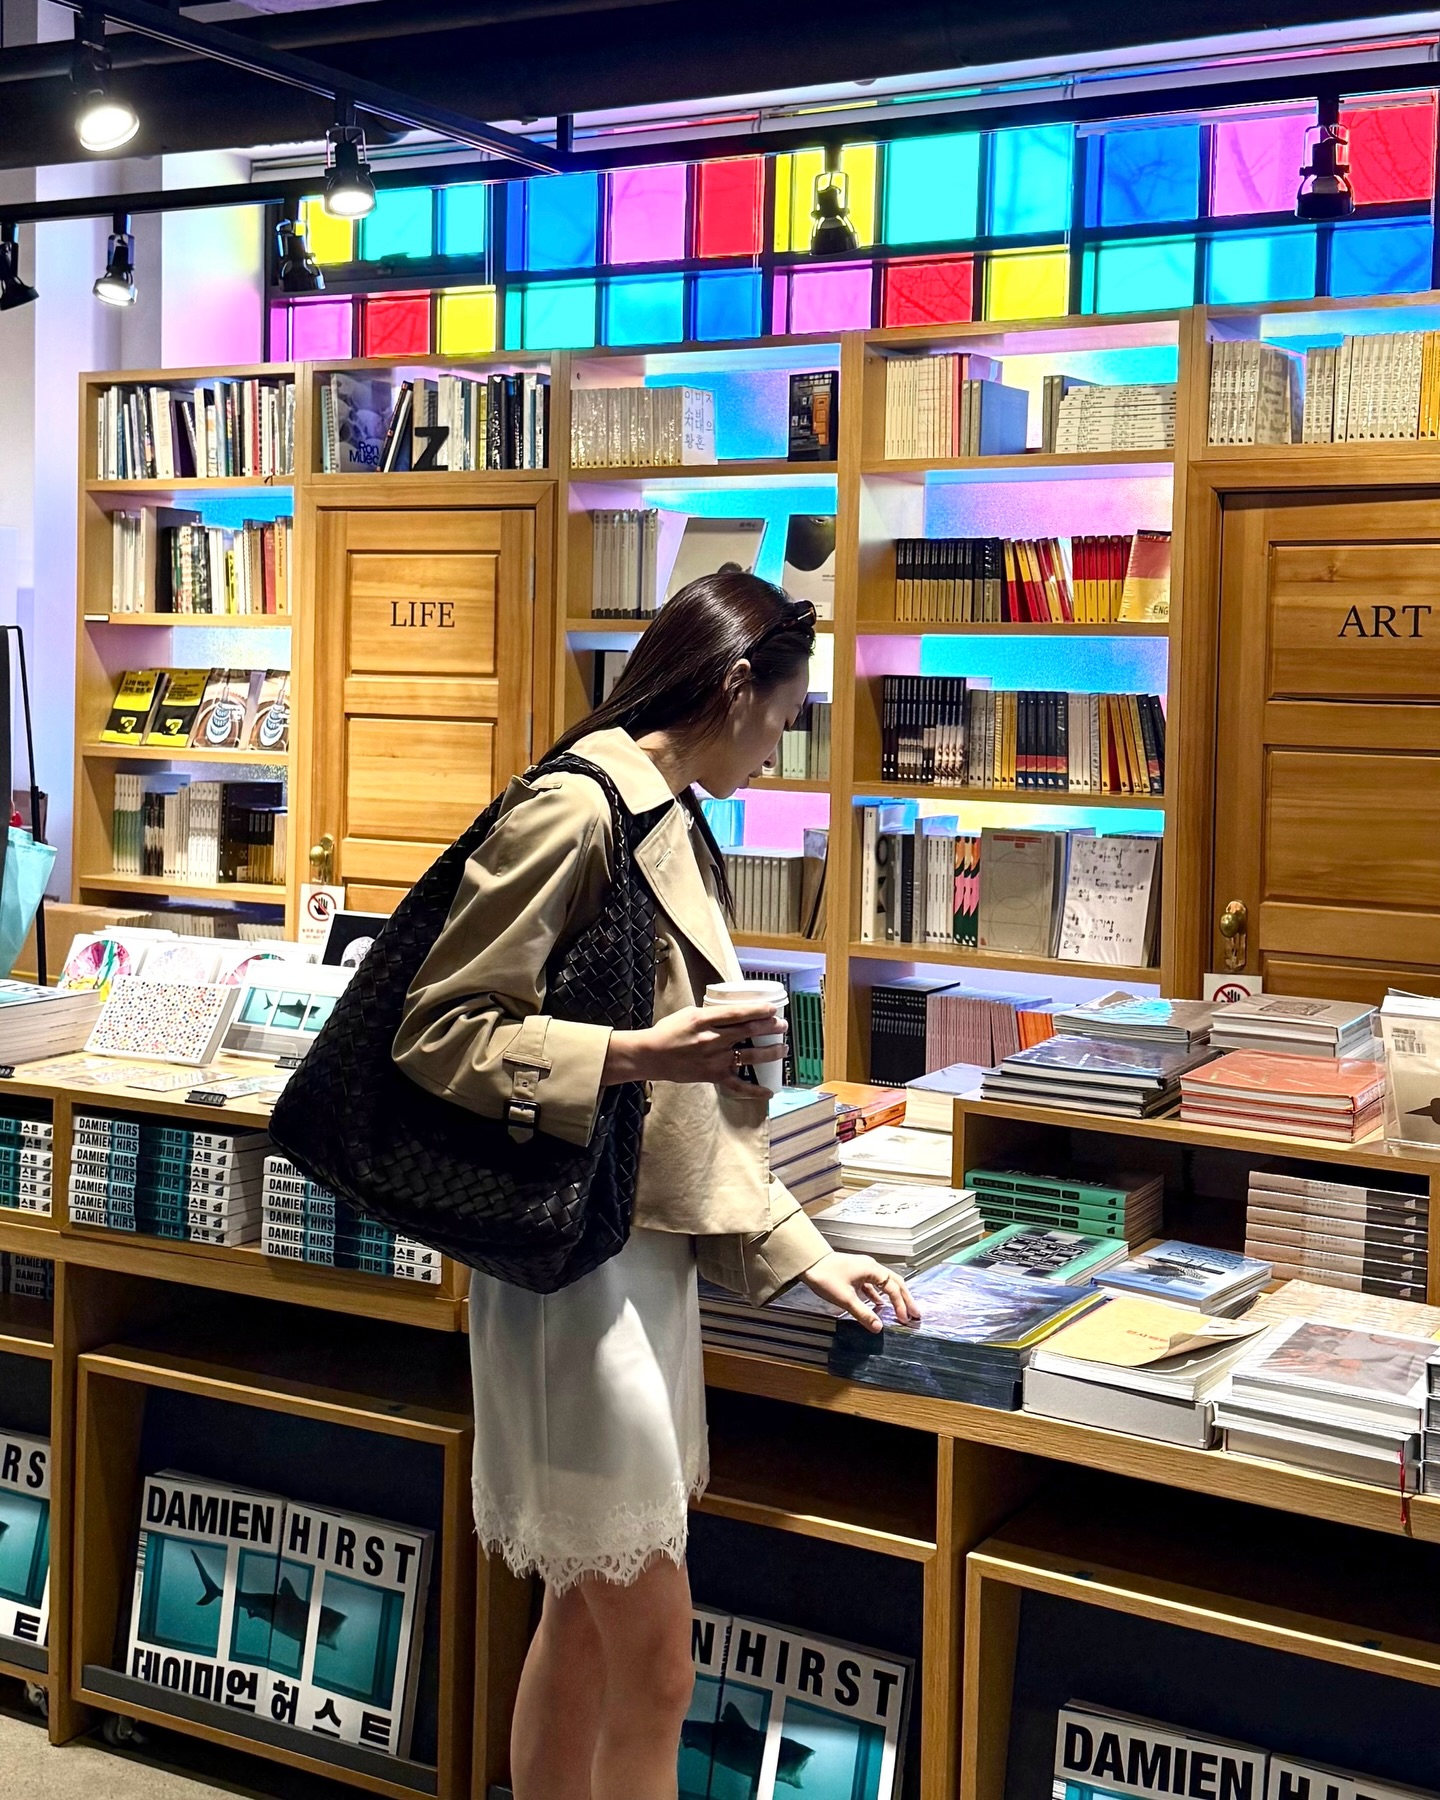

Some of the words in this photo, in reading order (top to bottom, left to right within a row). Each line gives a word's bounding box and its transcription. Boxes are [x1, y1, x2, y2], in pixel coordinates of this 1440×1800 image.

[349, 450, 380, 465] Muec
[359, 441, 380, 454] Ron
[390, 601, 455, 628] LIFE
[1337, 605, 1432, 638] ART
[79, 1118, 114, 1133] DAMIEN
[116, 1123, 140, 1137] HIRS
[80, 1133, 113, 1148] DAMIEN
[116, 1139, 140, 1152] HIRS
[76, 1149, 110, 1164] DAMIEN
[114, 1154, 137, 1168] HIRS
[76, 1164, 110, 1179] DAMIEN
[114, 1169, 136, 1183] HIRS
[75, 1179, 108, 1194] DAMIEN
[112, 1184, 135, 1198] HIRS
[270, 1178, 306, 1195] DAMIEN
[74, 1194, 108, 1210] DAMIEN
[112, 1200, 134, 1214] HIRS
[268, 1195, 305, 1211] DAMIEN
[310, 1201, 334, 1215] HIRS
[76, 1210, 110, 1224] DAMIEN
[113, 1215, 136, 1229] HIRS
[270, 1210, 306, 1226] DAMIEN
[310, 1216, 335, 1231] HIRS
[268, 1226, 305, 1242] DAMIEN
[310, 1233, 334, 1248] HIRS
[268, 1242, 304, 1258] DAMIEN
[308, 1249, 334, 1263] HIRS
[146, 1485, 274, 1544] DAMIEN
[289, 1513, 416, 1584] HIRST
[736, 1629, 898, 1717] HIRST
[271, 1680, 392, 1753] 허스트
[1063, 1722, 1254, 1800] DAMIEN
